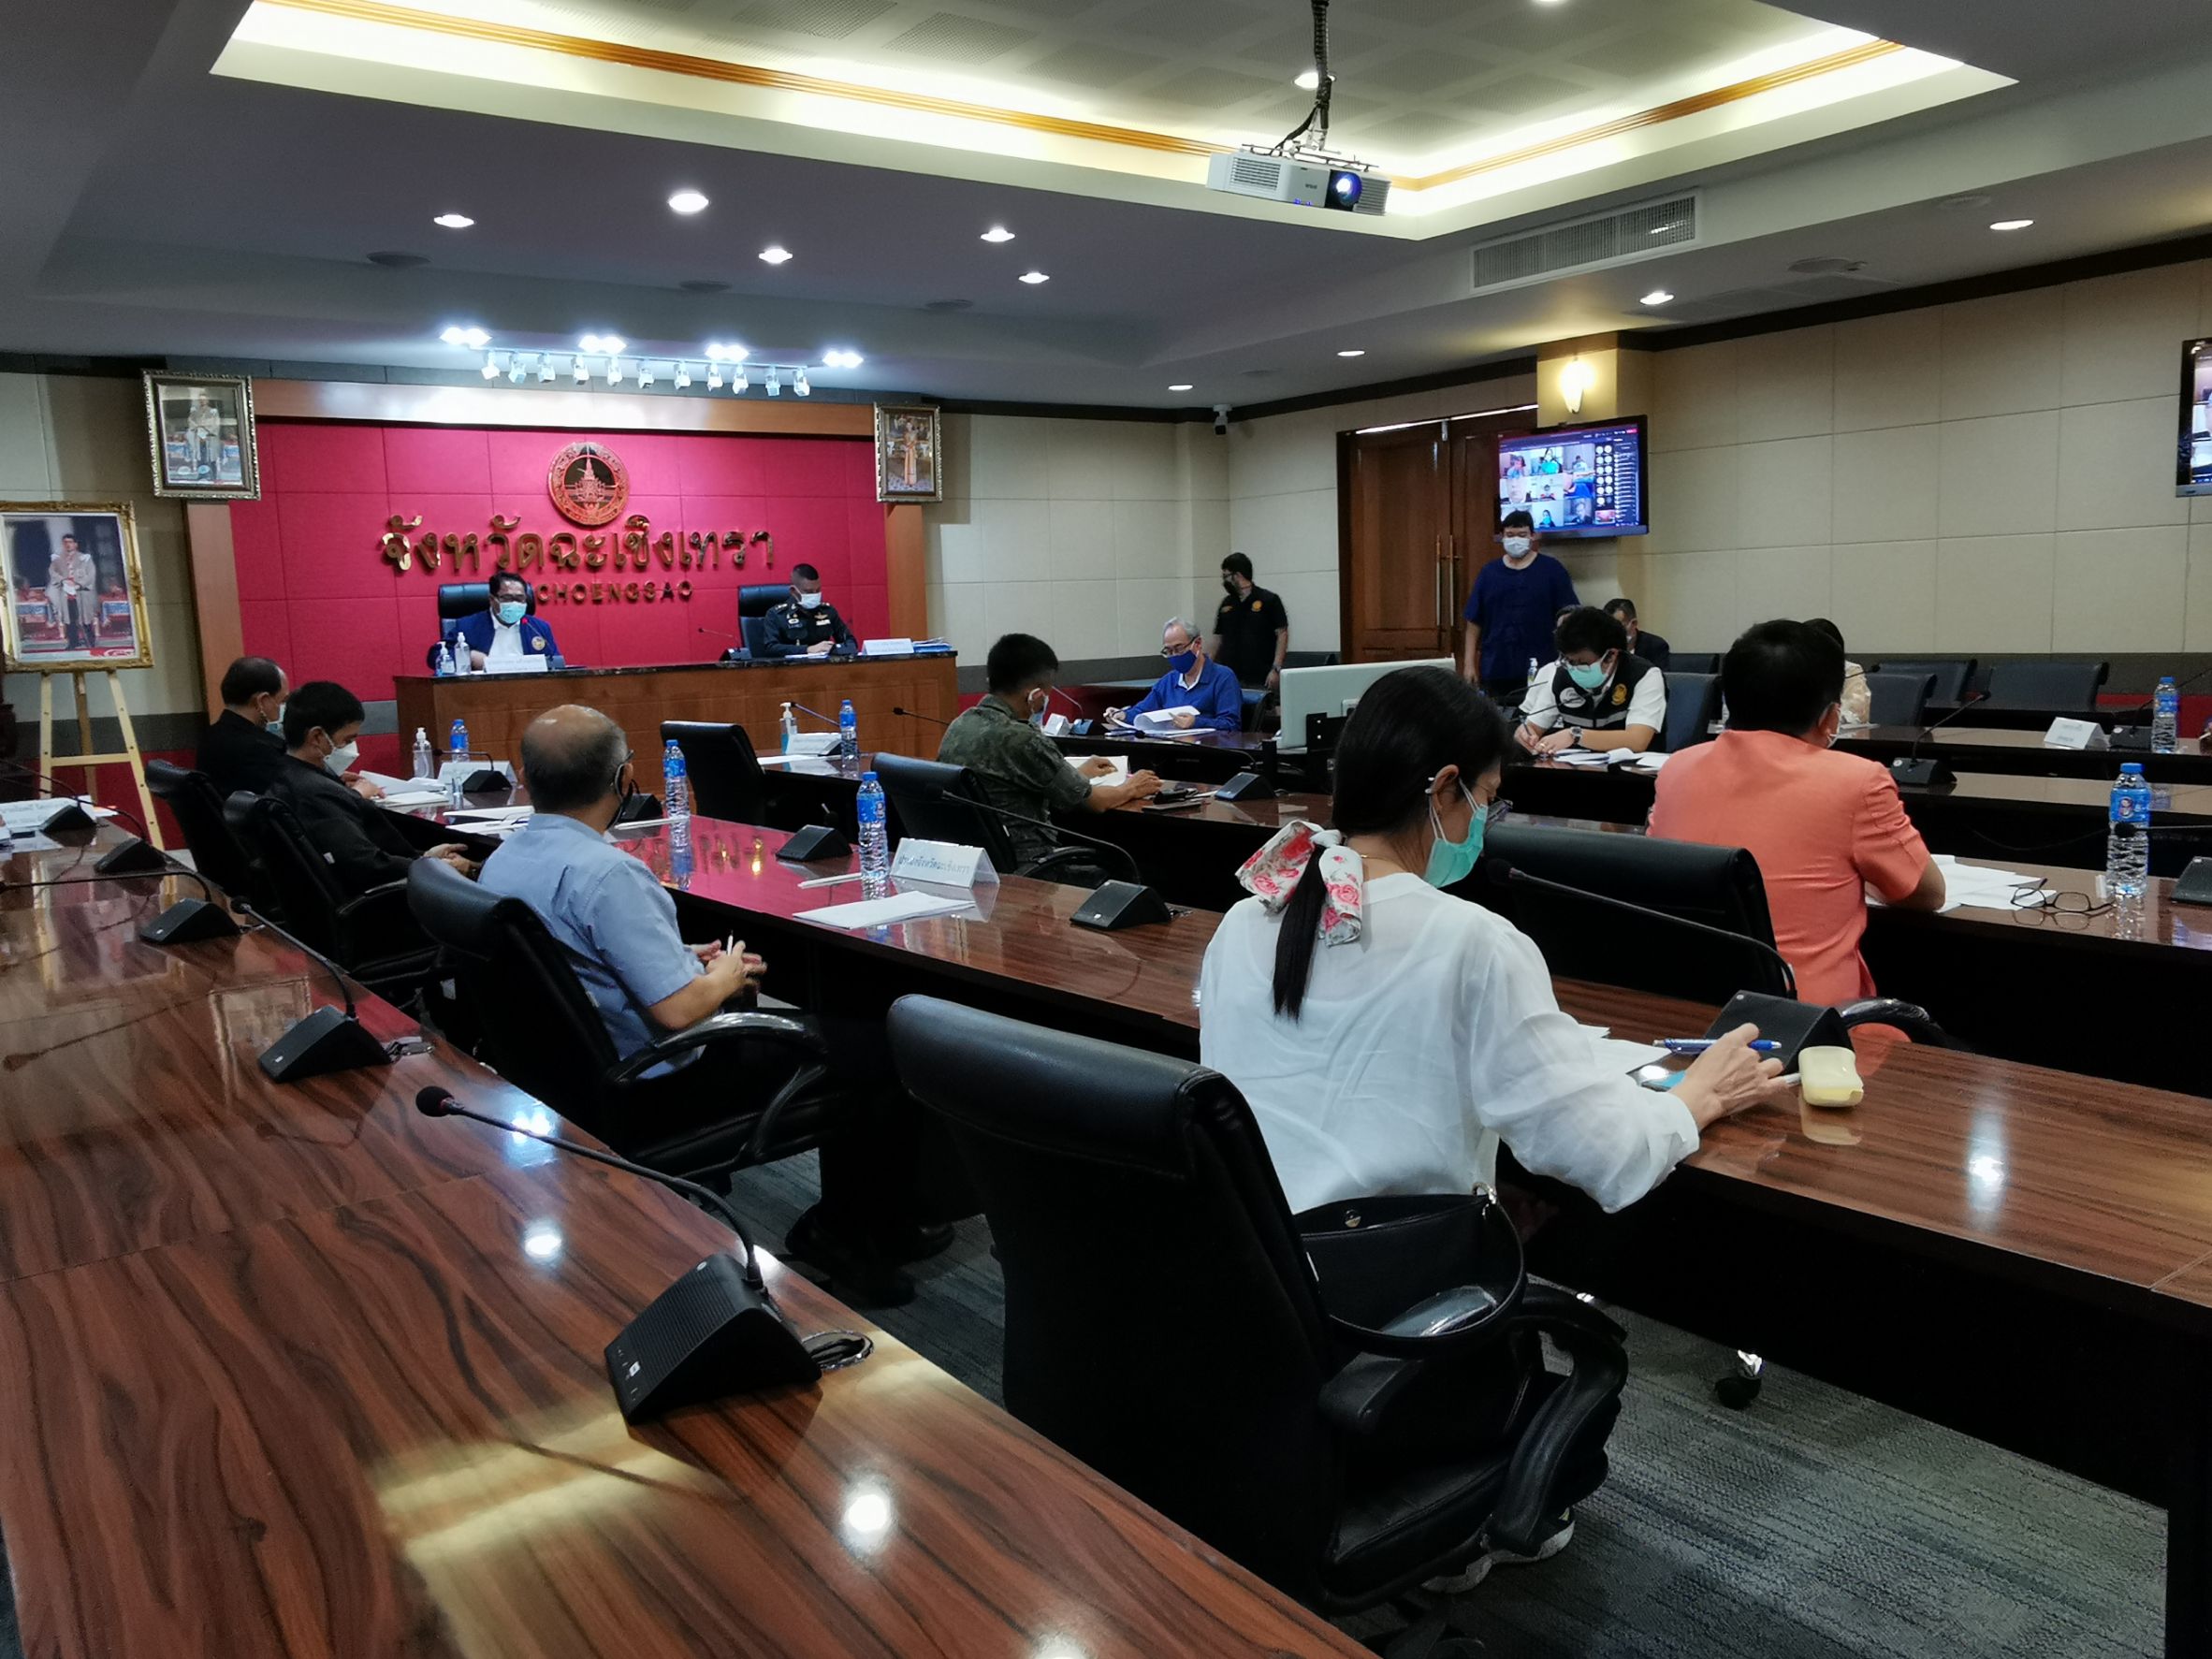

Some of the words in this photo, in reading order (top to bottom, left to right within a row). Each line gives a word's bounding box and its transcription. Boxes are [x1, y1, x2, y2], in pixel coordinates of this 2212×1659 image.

[381, 514, 775, 570] จังหวัดฉะเชิงเทรา
